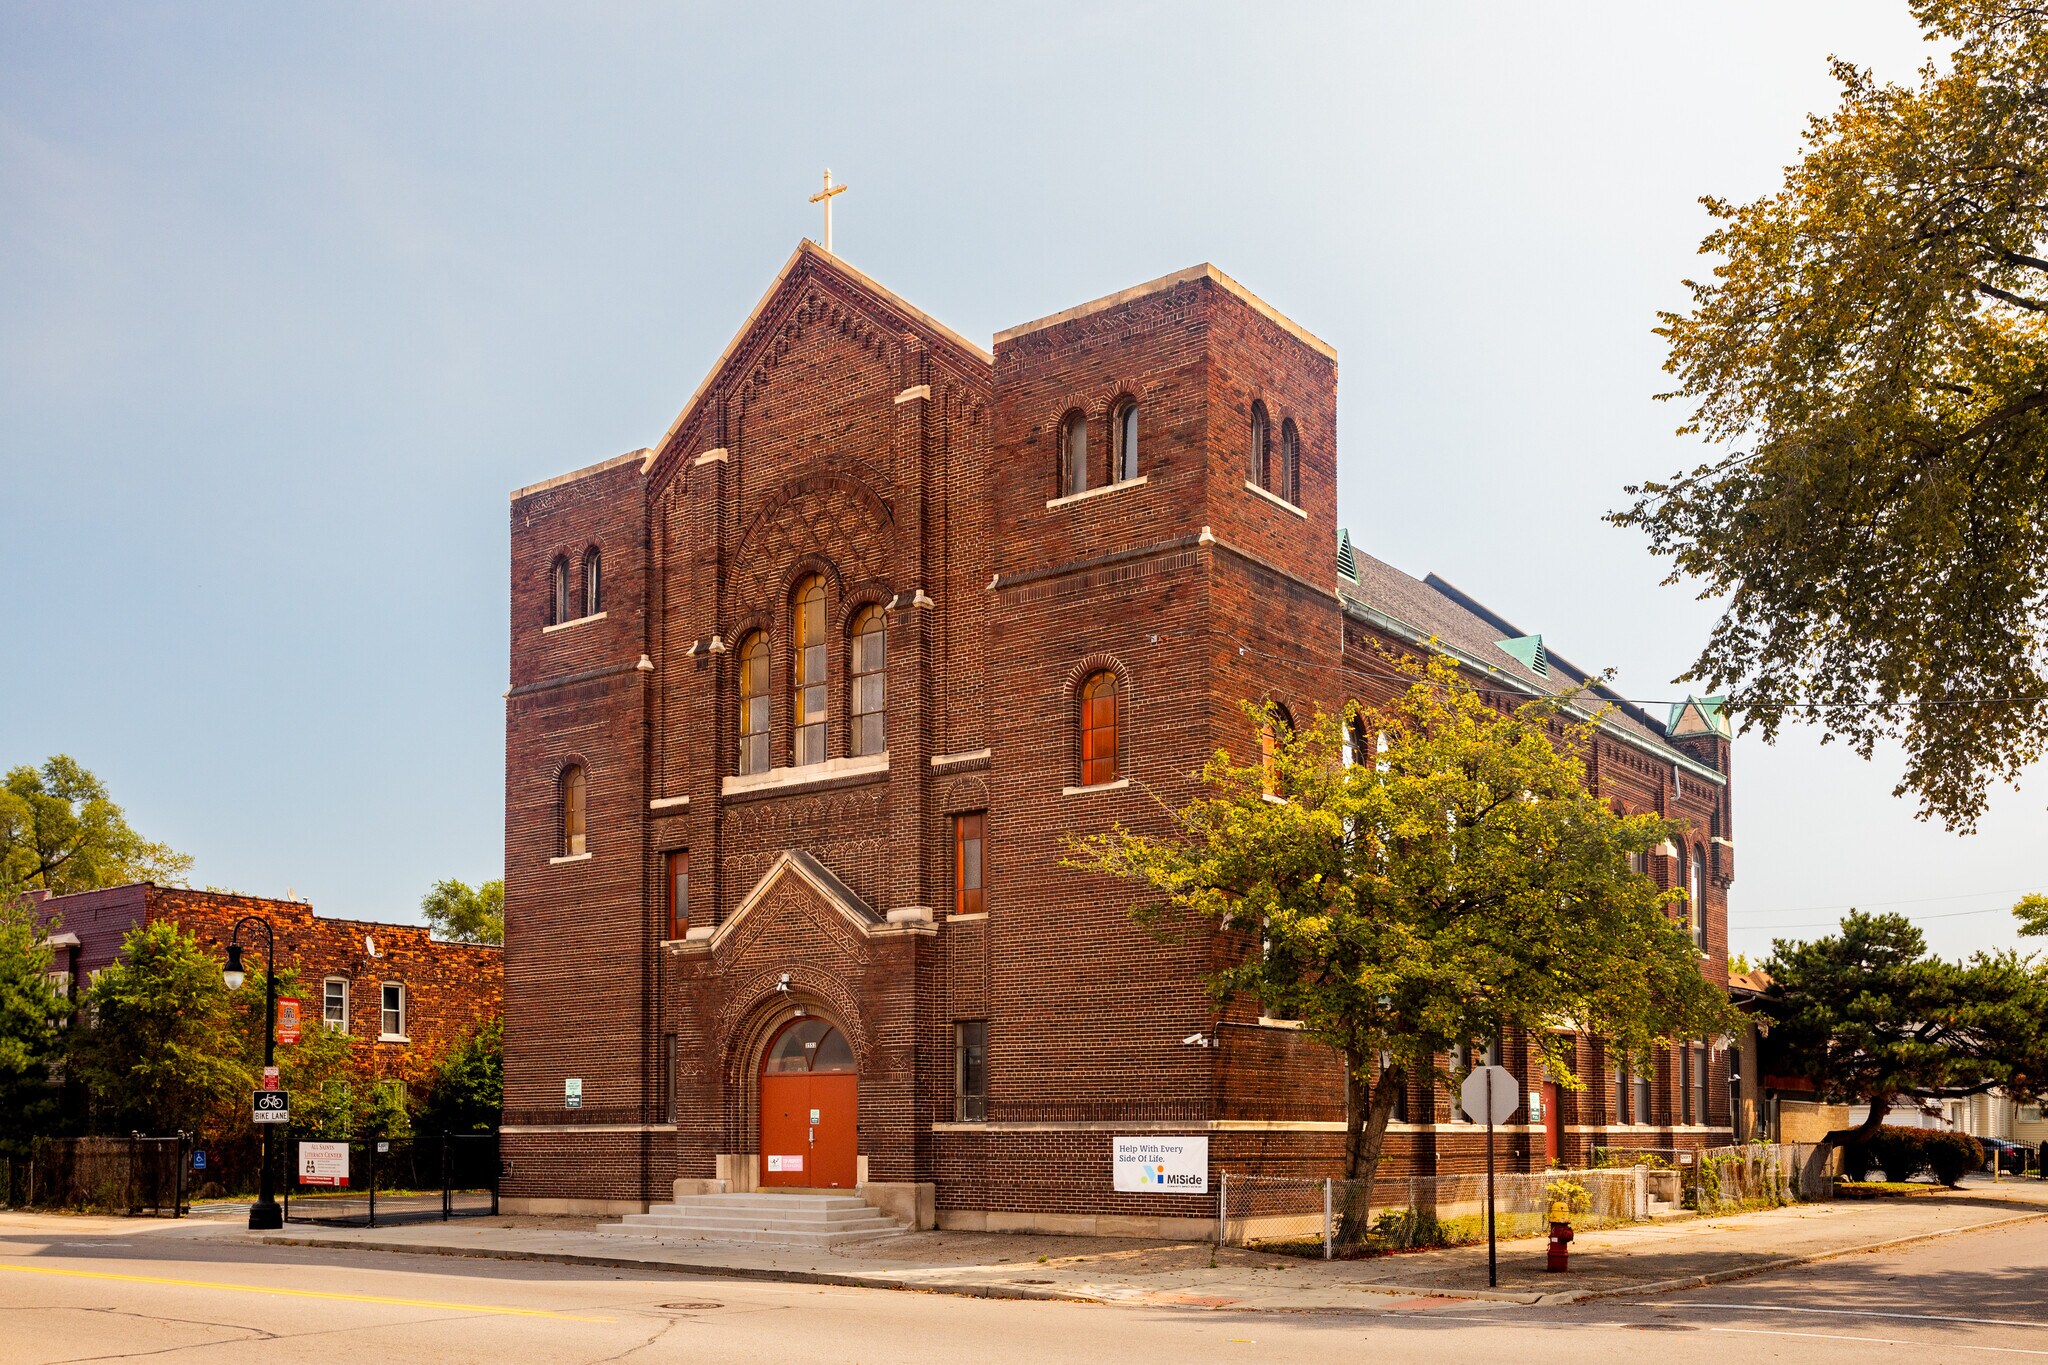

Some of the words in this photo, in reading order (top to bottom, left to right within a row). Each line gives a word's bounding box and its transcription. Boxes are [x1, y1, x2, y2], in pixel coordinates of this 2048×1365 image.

[1120, 1145, 1138, 1154] Help
[1160, 1145, 1184, 1154] Every
[1167, 1174, 1202, 1184] MiSide
